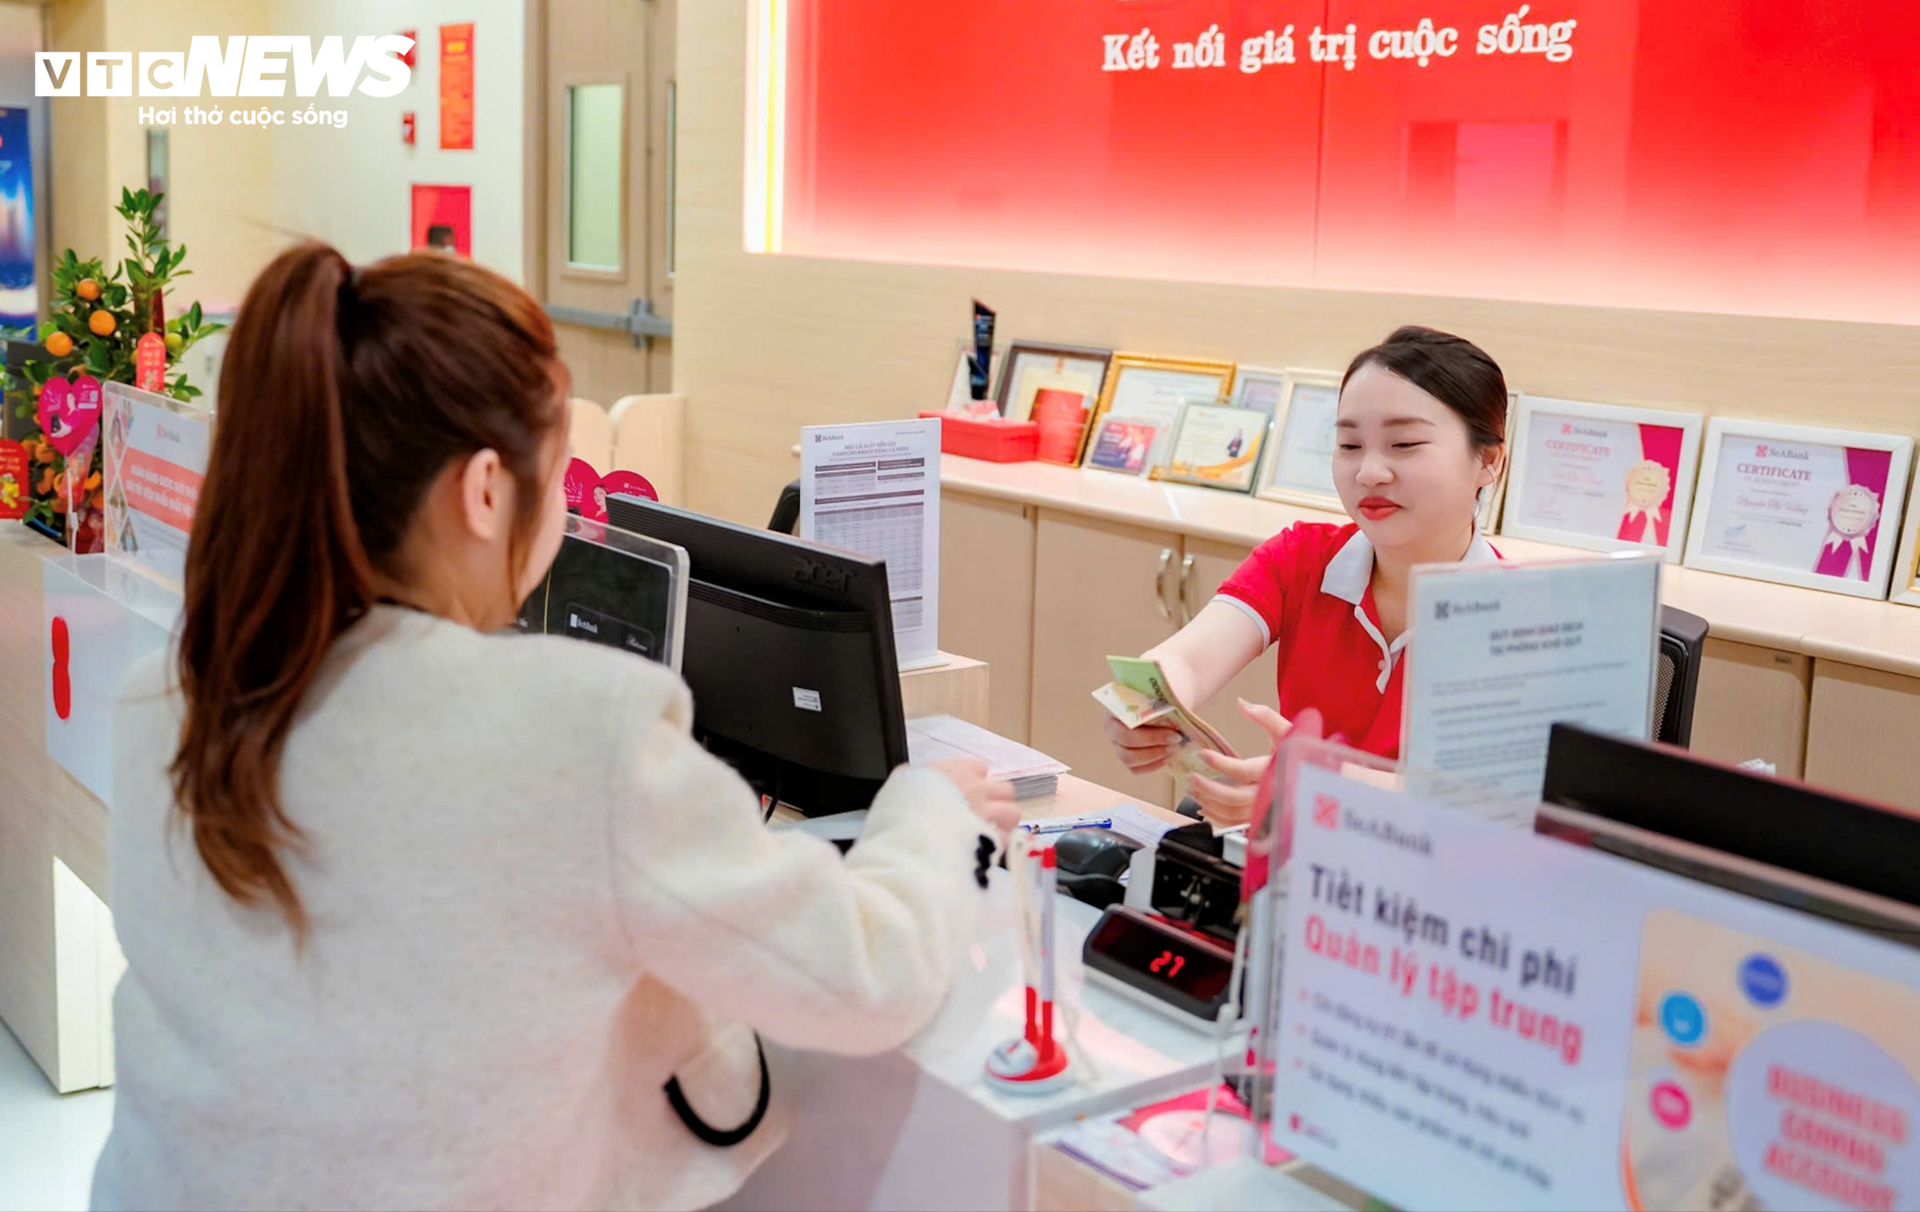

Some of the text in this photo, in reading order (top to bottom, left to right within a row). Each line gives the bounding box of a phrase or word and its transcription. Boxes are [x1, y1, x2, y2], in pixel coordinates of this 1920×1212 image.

[1102, 4, 1577, 74] Kết nối giá trị cuộc sống
[1545, 438, 1612, 457] CERTIFICATE
[1736, 462, 1812, 481] CERTIFICATE
[1769, 448, 1810, 460] SeABank
[1308, 863, 1578, 997] Tiết kiệm chi phí
[1304, 913, 1381, 976] Quản
[1389, 948, 1418, 997] lý
[1428, 961, 1480, 1020] tập
[1489, 990, 1585, 1067] trung
[1767, 1062, 1908, 1146] BUSINESS
